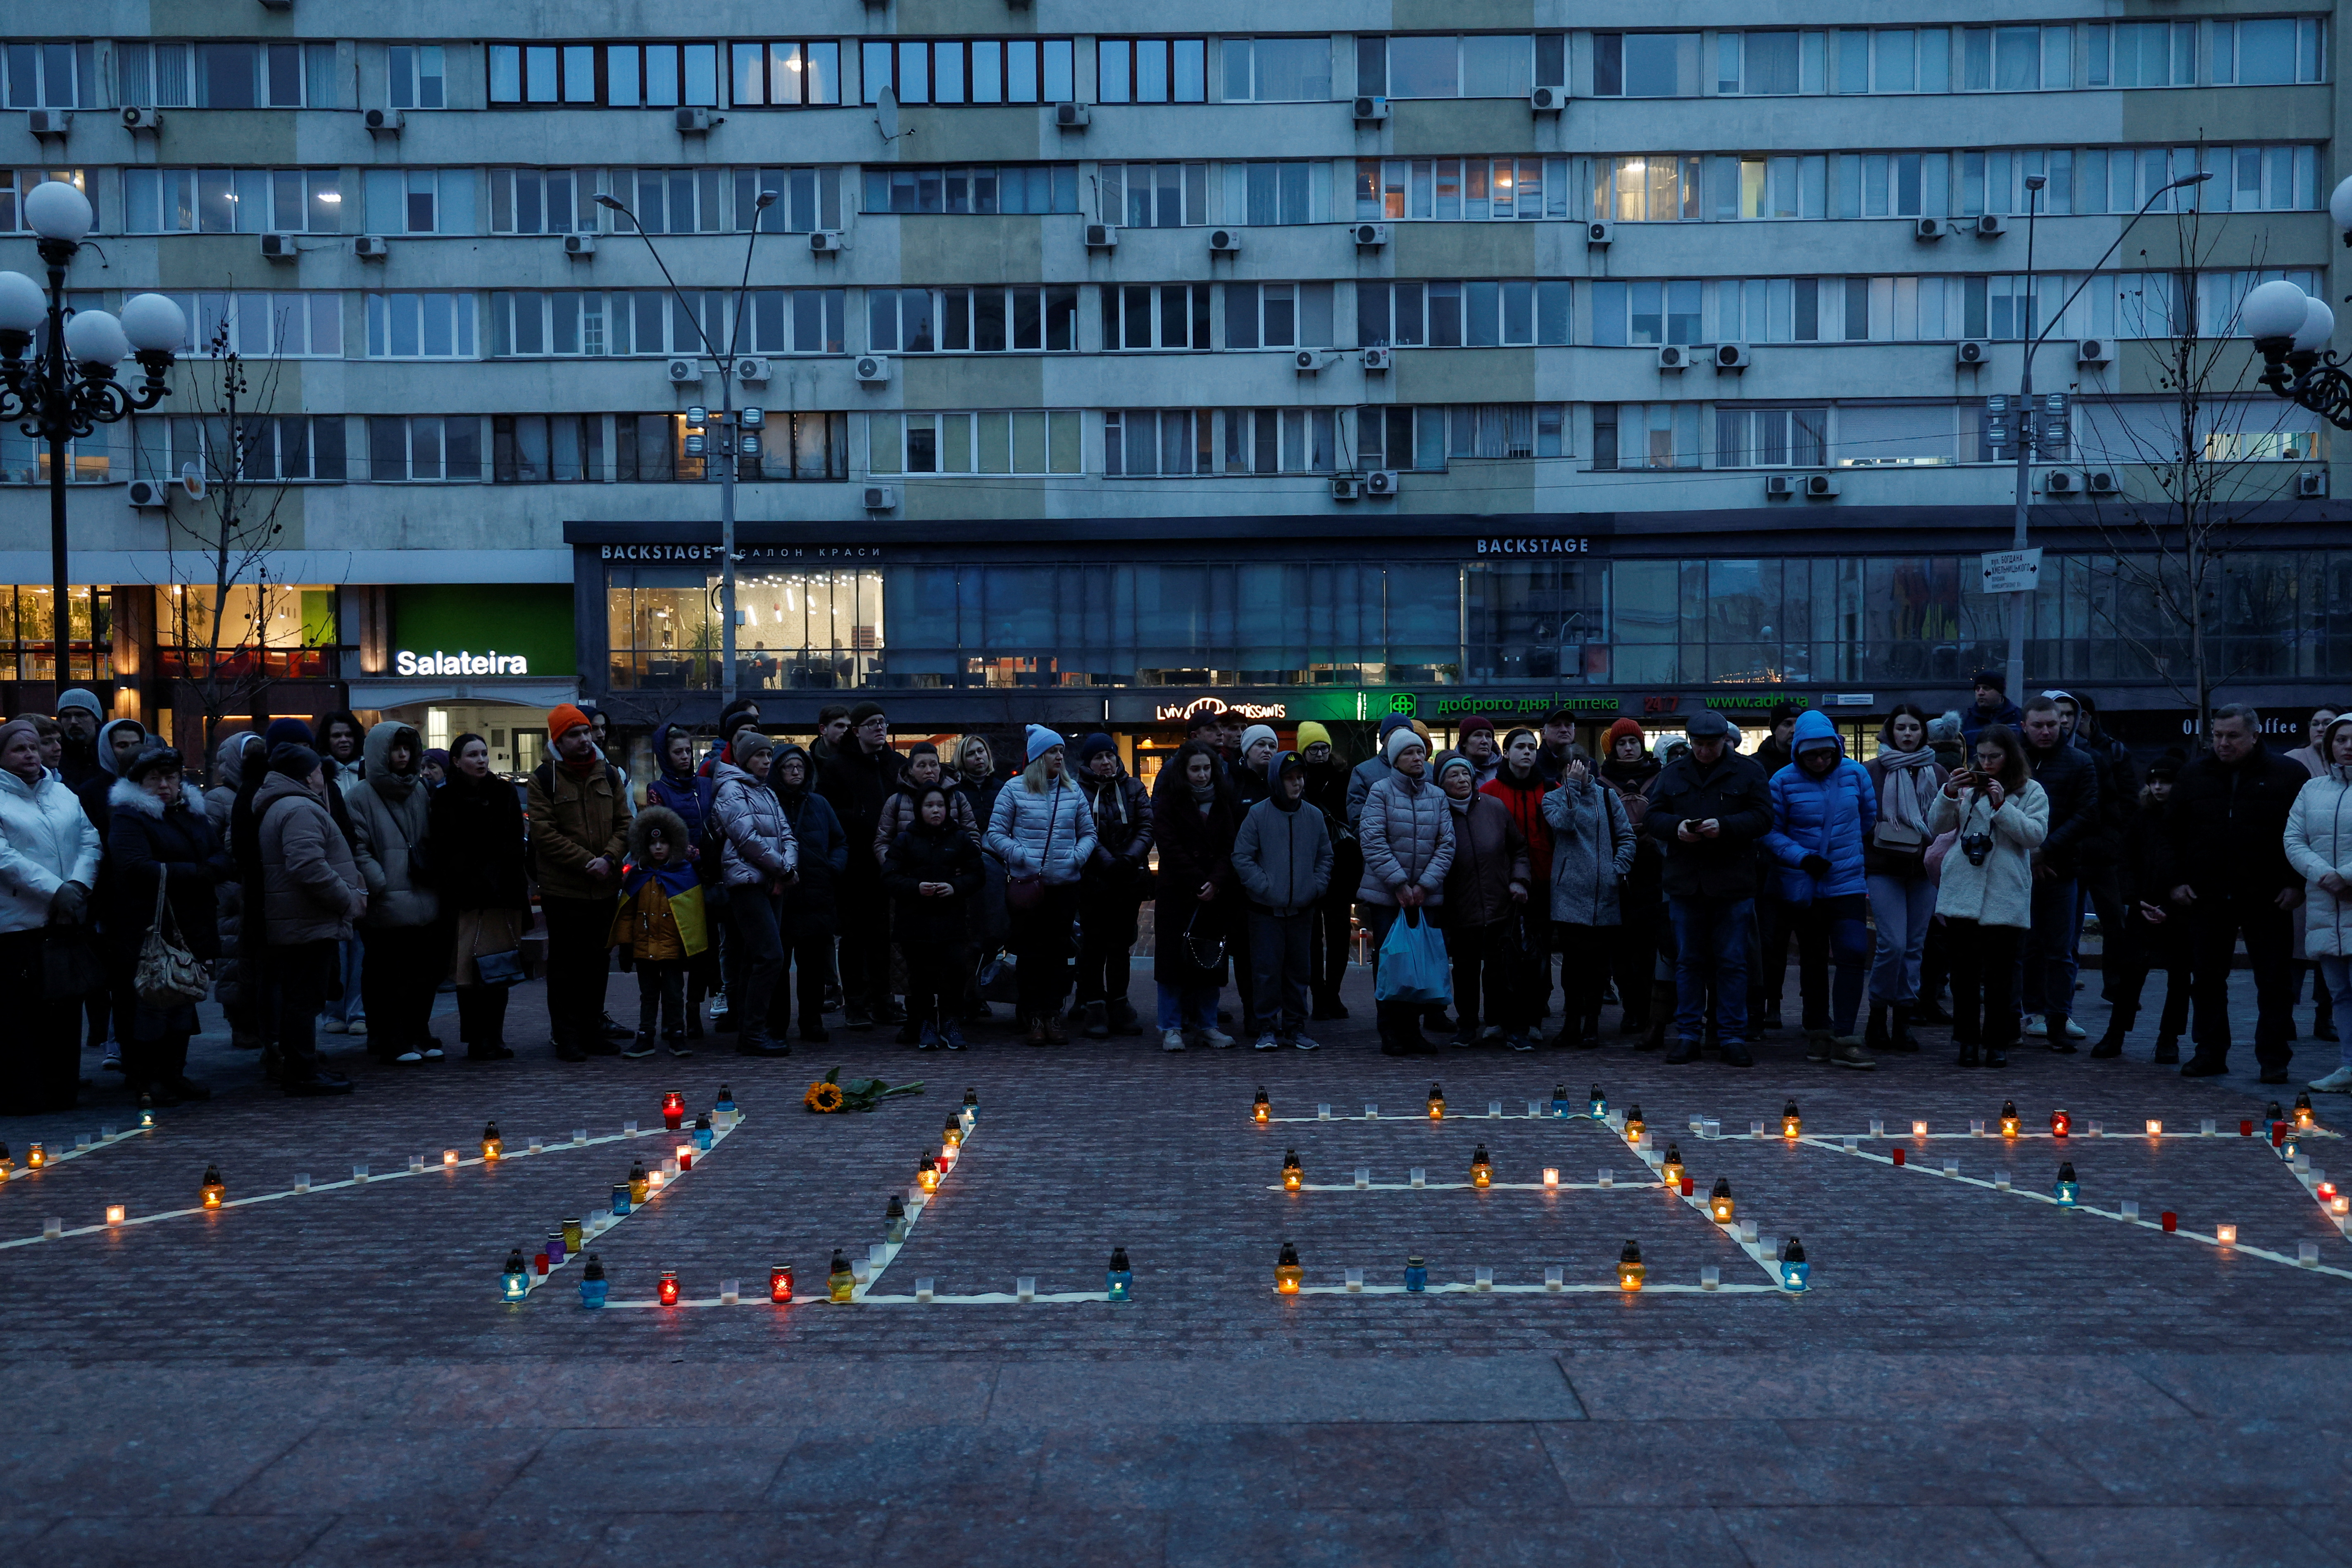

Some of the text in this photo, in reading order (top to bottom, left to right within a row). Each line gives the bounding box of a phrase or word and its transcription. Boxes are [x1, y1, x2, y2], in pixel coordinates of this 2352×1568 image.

[601, 545, 712, 559] BACKSTAGE
[739, 548, 881, 557] САЛОН КРАСИ
[1477, 538, 1589, 554] BACKSTAGE
[2001, 554, 2023, 564] БОГДАНА
[1992, 563, 2031, 574] ХМЕЛЬНИЦЬКОГО
[397, 650, 528, 676] Salateira
[1157, 703, 1184, 720] Lviv
[1437, 695, 1619, 714] доброго дня аптека
[1643, 696, 1679, 712] 24/7
